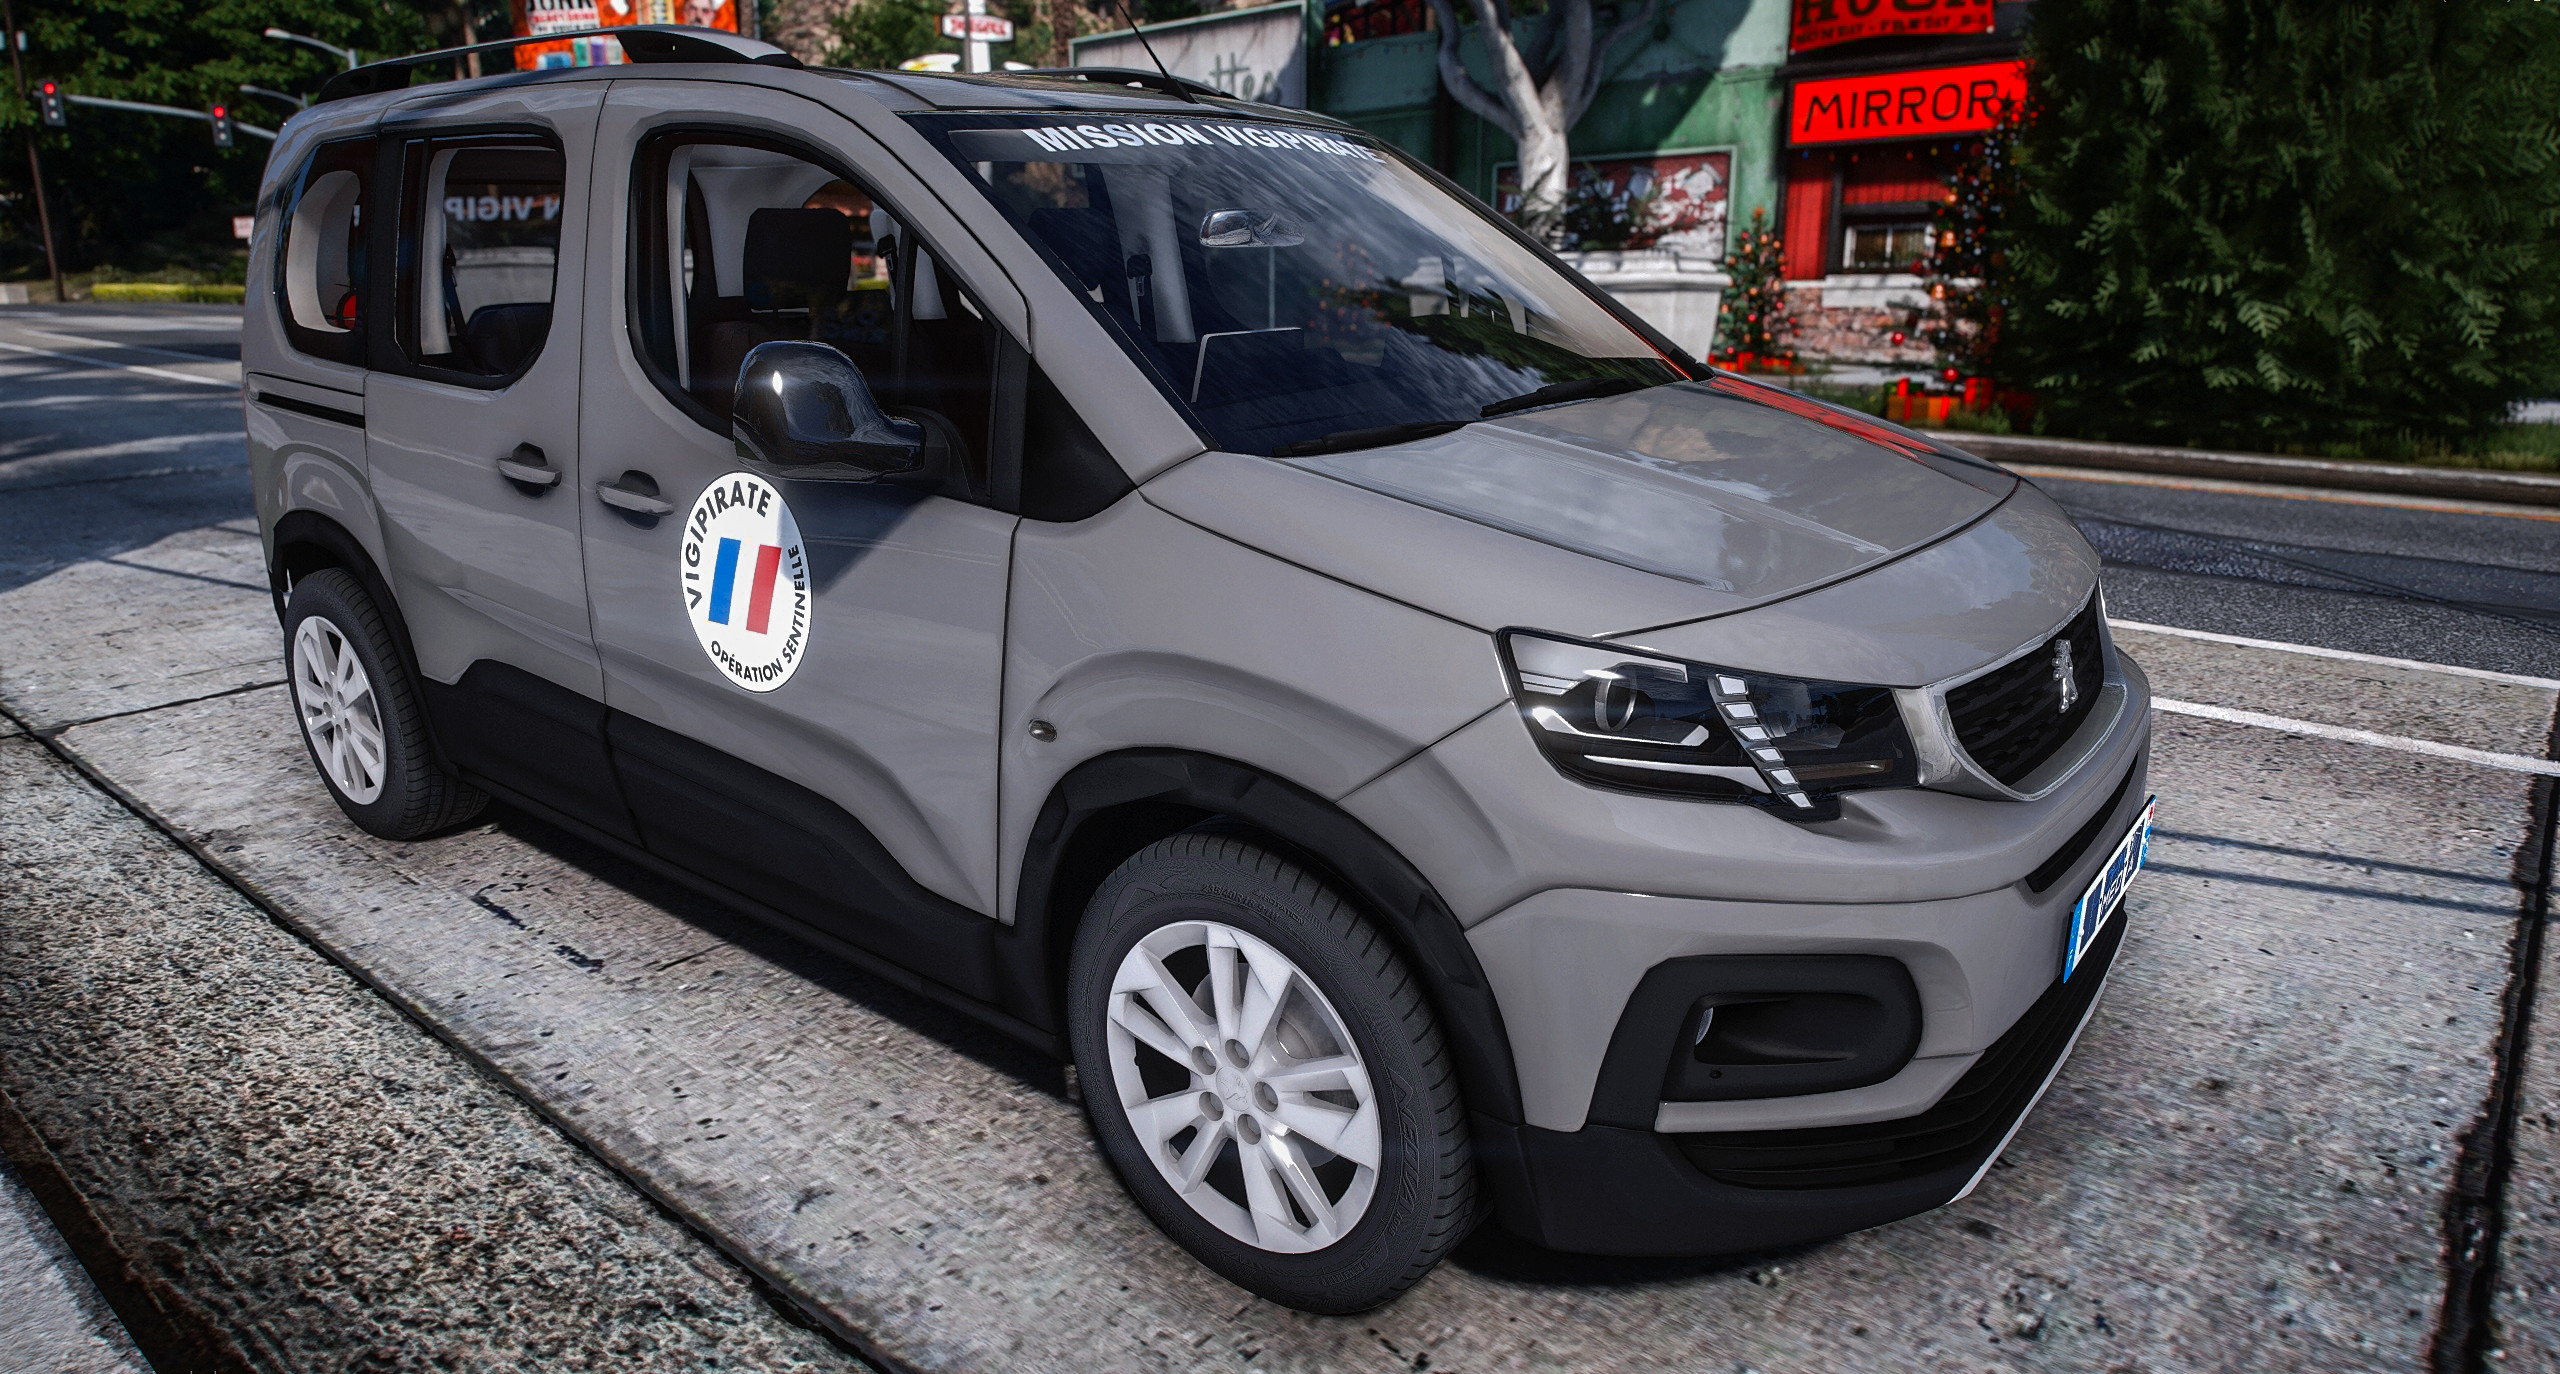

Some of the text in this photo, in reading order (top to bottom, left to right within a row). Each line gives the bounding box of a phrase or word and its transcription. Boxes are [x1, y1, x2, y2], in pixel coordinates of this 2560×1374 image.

[1021, 123, 1388, 165] MISSION VIGIPIRATE
[1804, 80, 1998, 132] MIRROR
[685, 480, 772, 610] VIGIPIRATE
[711, 544, 806, 683] OPÉRATION SENTINELLE
